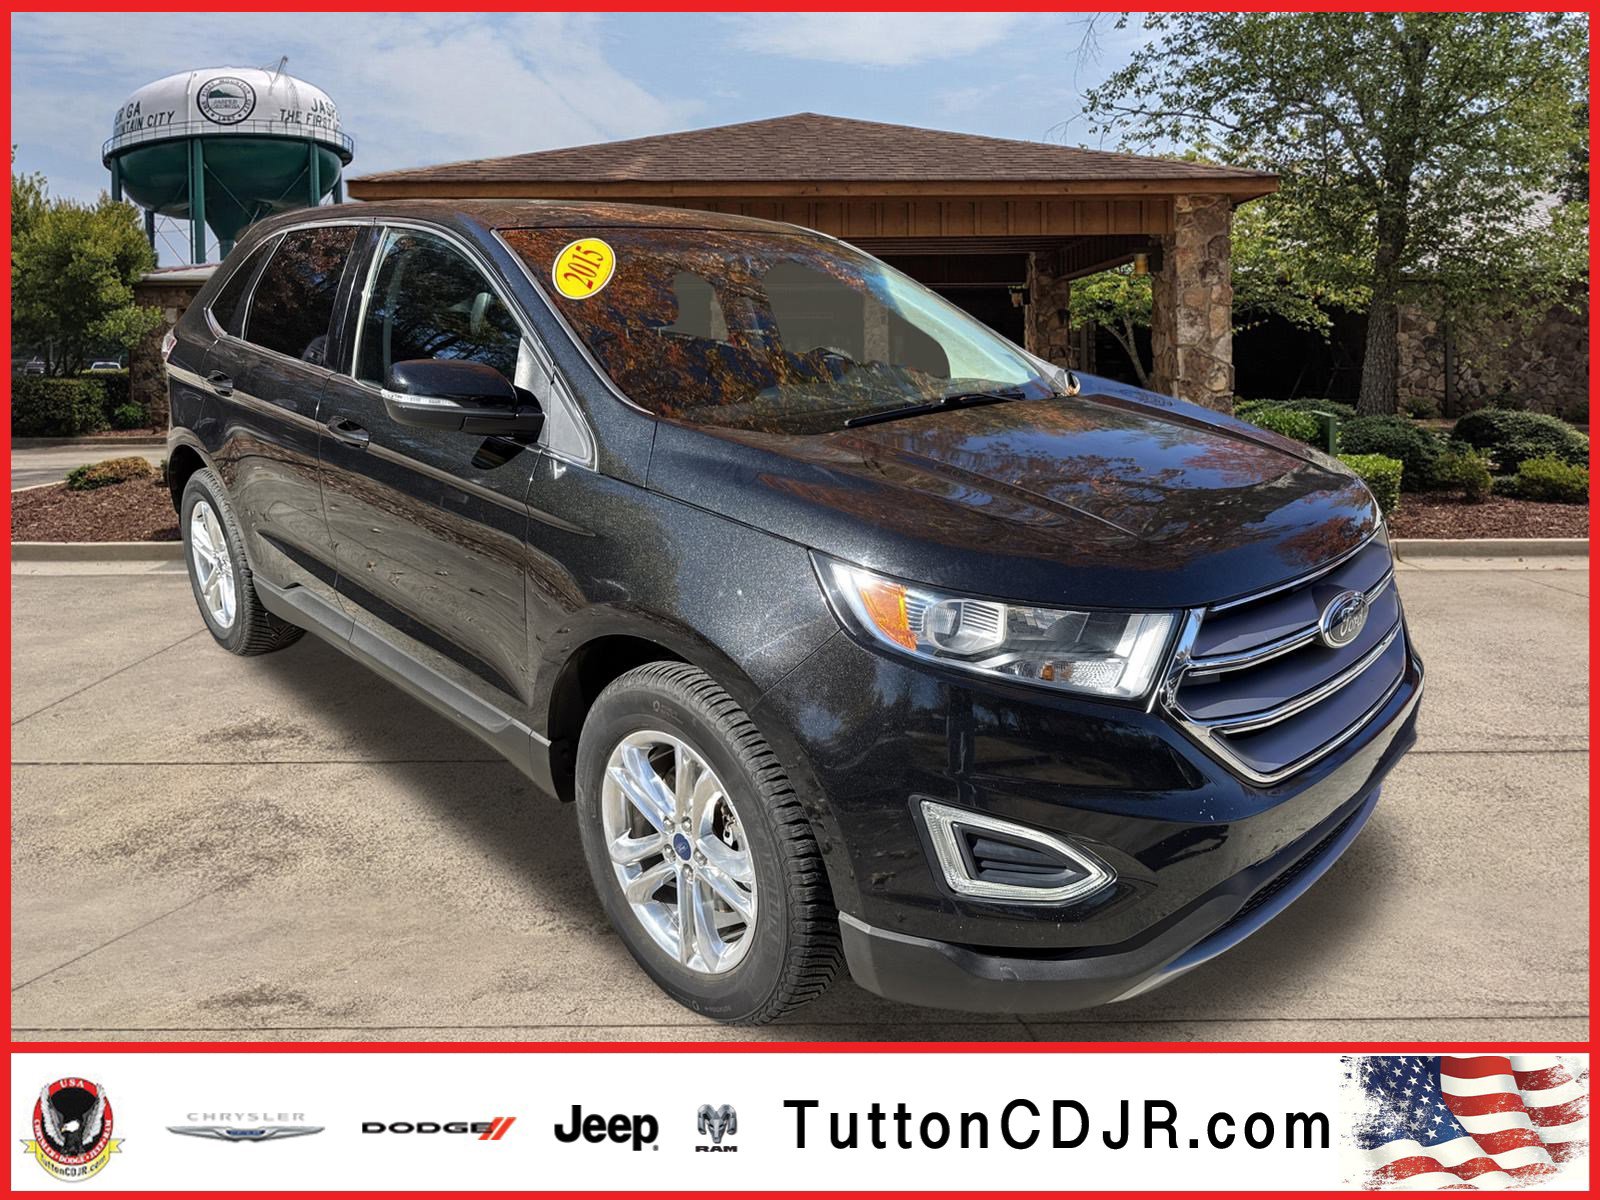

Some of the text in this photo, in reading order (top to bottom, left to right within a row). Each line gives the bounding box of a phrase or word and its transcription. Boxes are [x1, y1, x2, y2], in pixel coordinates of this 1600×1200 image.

[127, 101, 140, 119] GA
[147, 111, 175, 127] CITY
[280, 109, 302, 124] THE
[306, 112, 331, 130] FIRST
[563, 245, 604, 290] 2015
[1340, 600, 1364, 637] Ford
